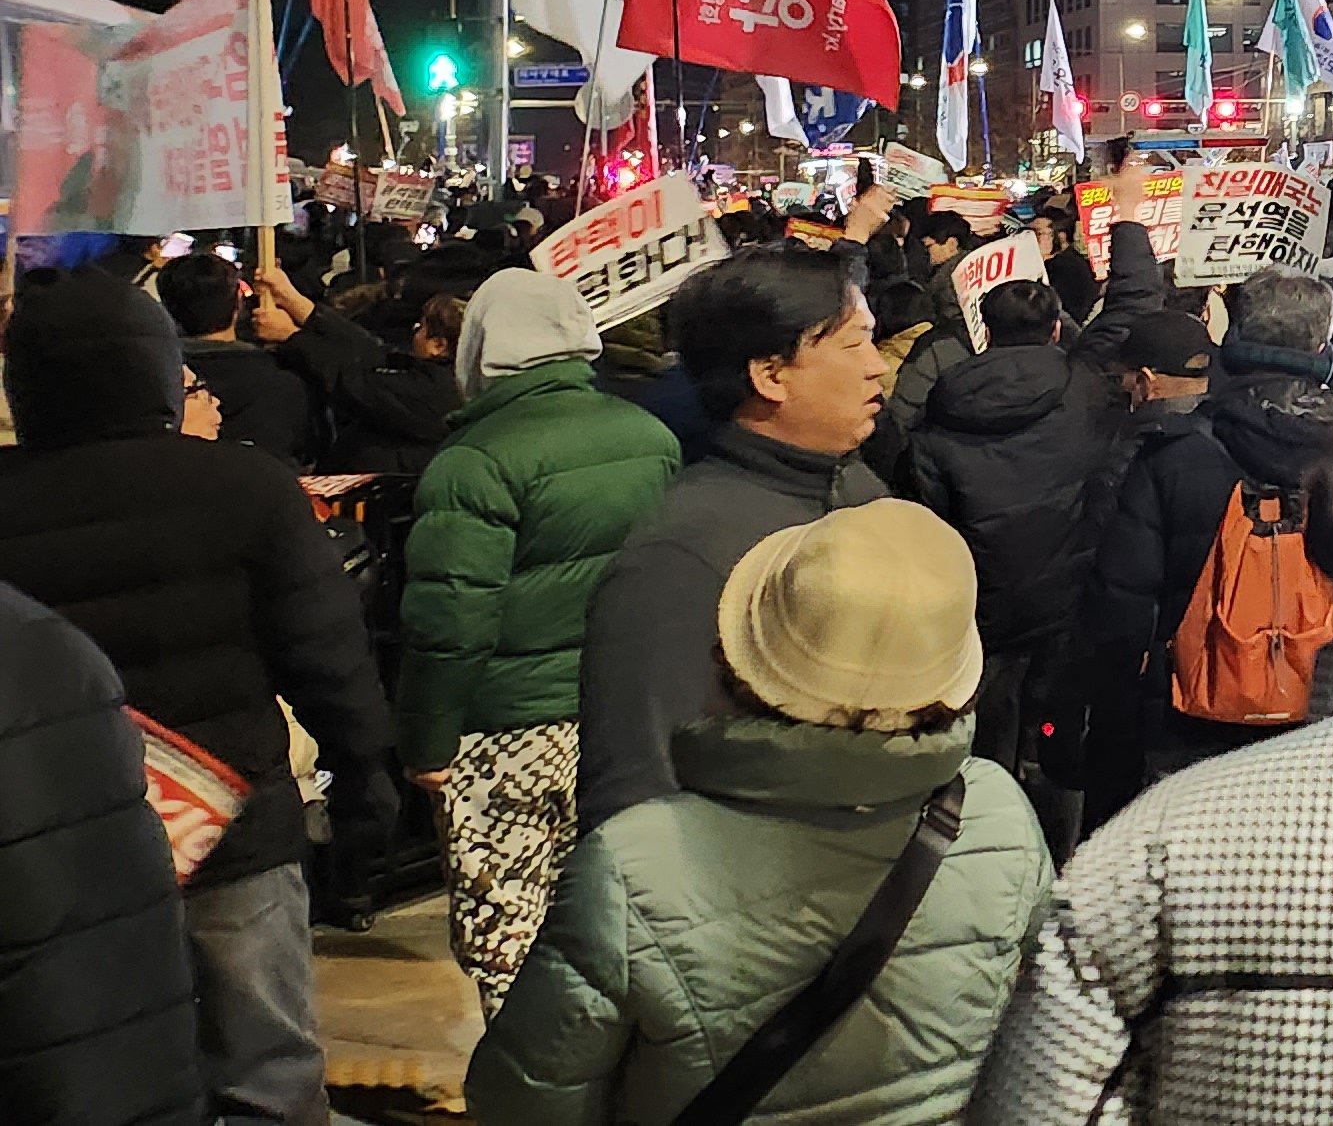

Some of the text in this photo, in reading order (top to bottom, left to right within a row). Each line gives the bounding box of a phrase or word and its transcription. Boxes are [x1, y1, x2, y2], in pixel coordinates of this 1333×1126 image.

[1124, 97, 1137, 108] 50
[1193, 169, 1322, 216] 친일매국노
[550, 188, 665, 279] 탄핵이
[1190, 201, 1310, 241] 윤석열을
